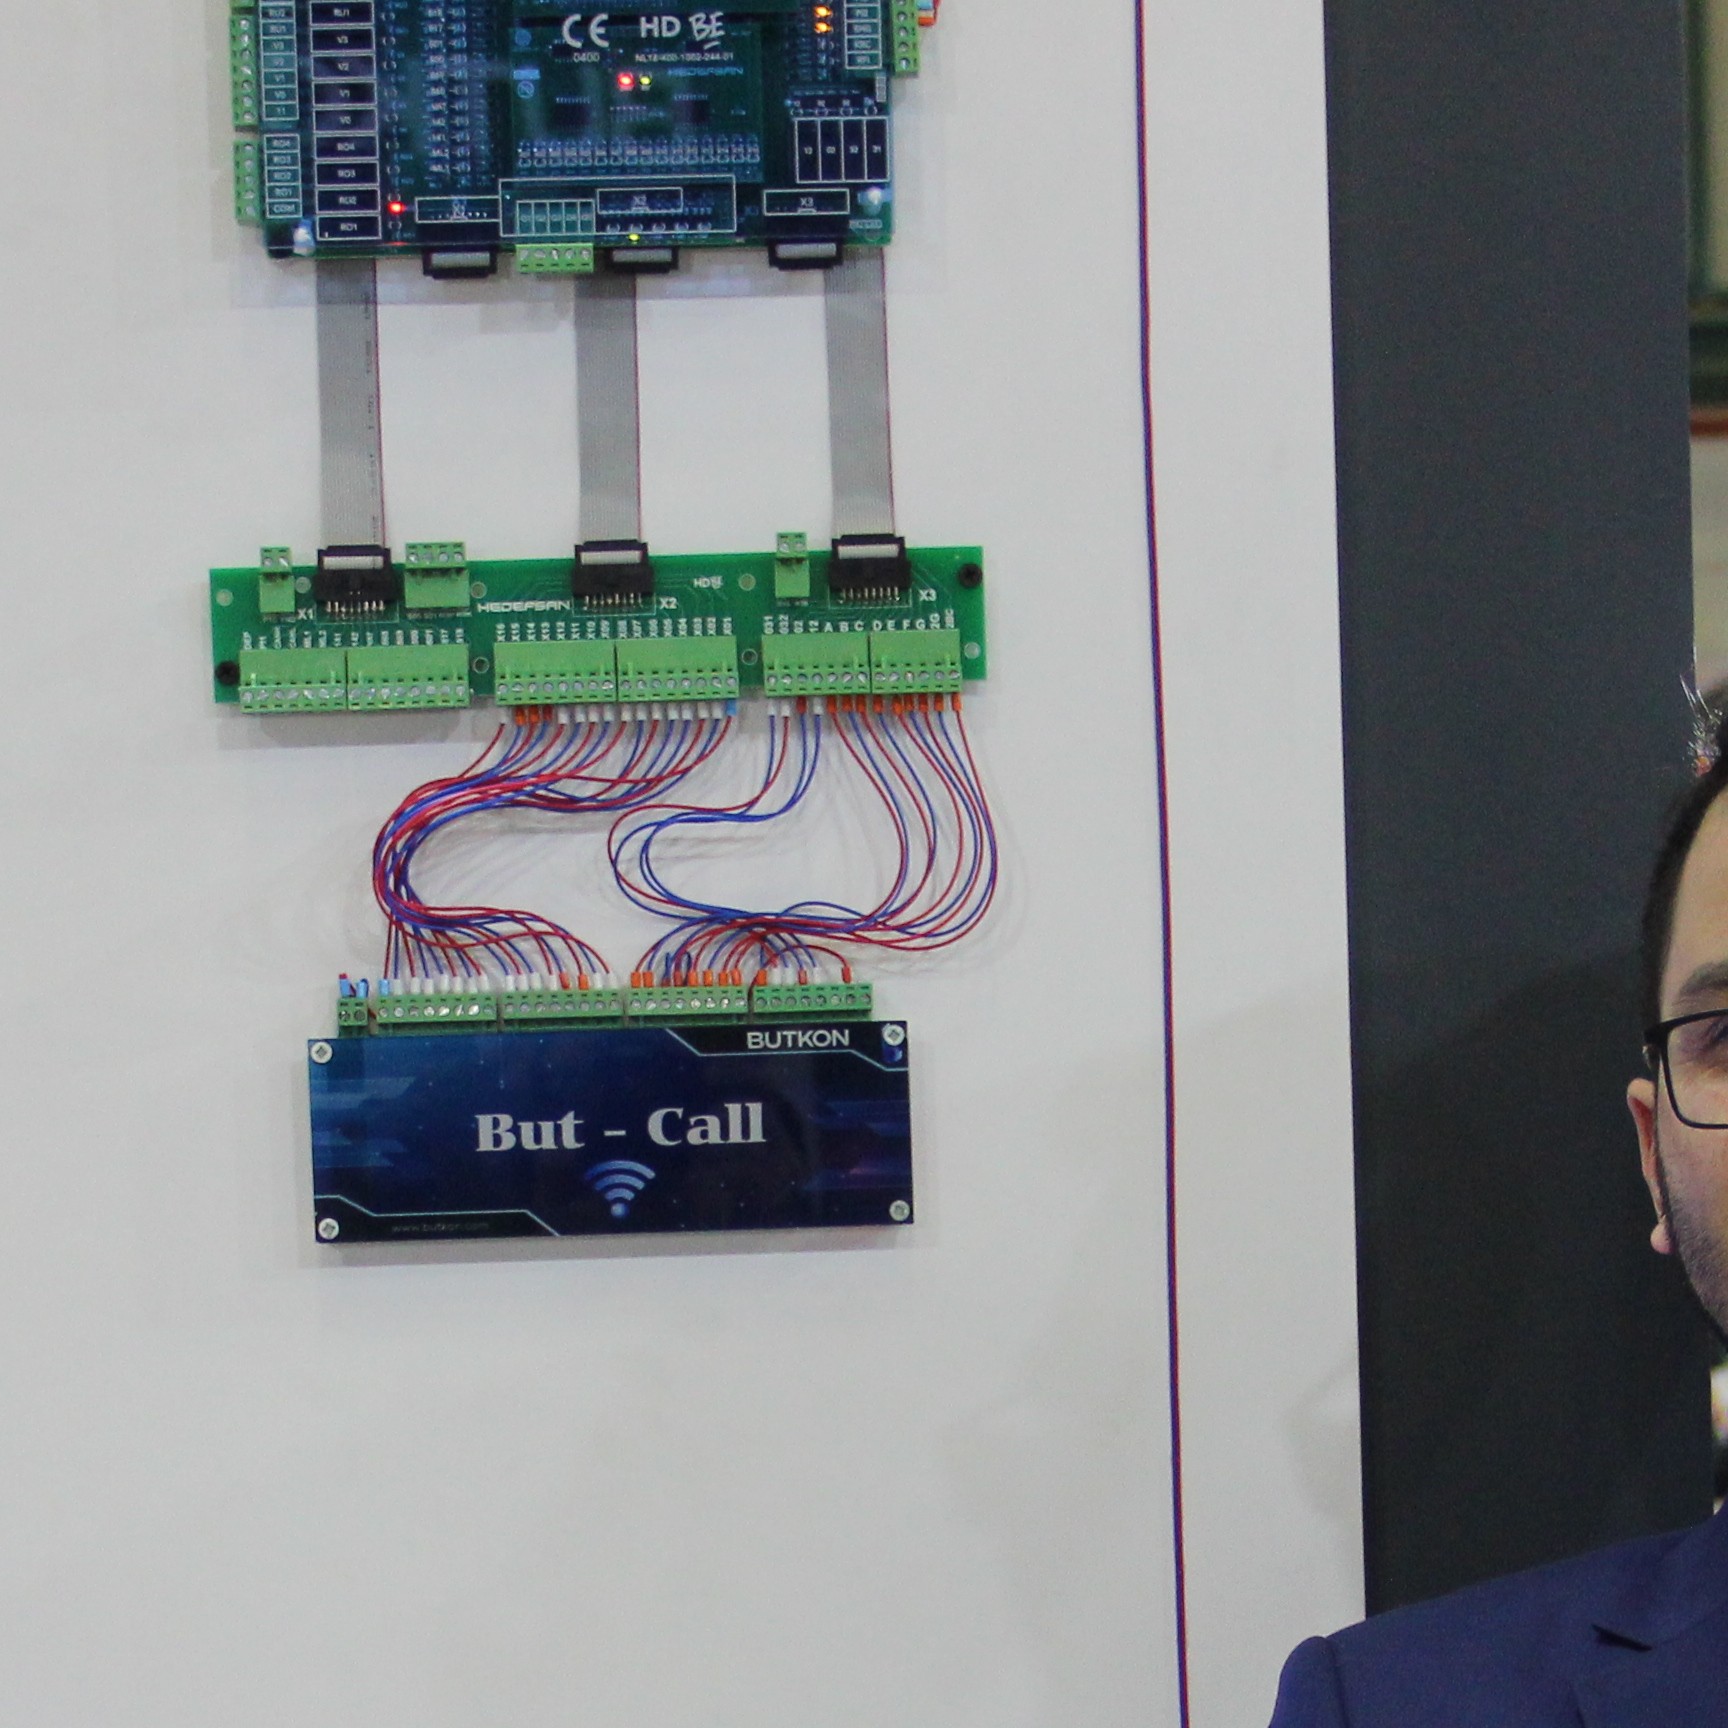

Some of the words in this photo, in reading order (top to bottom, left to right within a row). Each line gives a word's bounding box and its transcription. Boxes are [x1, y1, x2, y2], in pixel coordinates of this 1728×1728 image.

[640, 16, 681, 38] HD
[573, 52, 600, 63] 0400
[801, 198, 814, 206] X3
[660, 597, 677, 609] X2
[919, 589, 937, 601] X3
[297, 608, 314, 620] X1
[477, 600, 571, 613] HEDEFSAN
[527, 622, 536, 642] X14
[541, 622, 551, 641] X13
[556, 621, 565, 640] X12
[571, 622, 580, 640] X11
[586, 621, 596, 640] X10
[632, 620, 642, 639] X07
[678, 618, 688, 637] X04
[707, 617, 717, 636] X02
[722, 617, 732, 636] X01
[794, 620, 804, 633] 02
[809, 620, 819, 633] 12
[824, 622, 834, 632] A
[839, 621, 849, 632] B
[854, 621, 865, 631] C
[873, 621, 882, 631] D
[887, 620, 895, 630] E
[903, 620, 910, 630] F
[915, 619, 925, 630] G
[747, 1029, 850, 1049] BUTKON
[474, 1111, 585, 1151] But
[647, 1102, 767, 1146] Call
